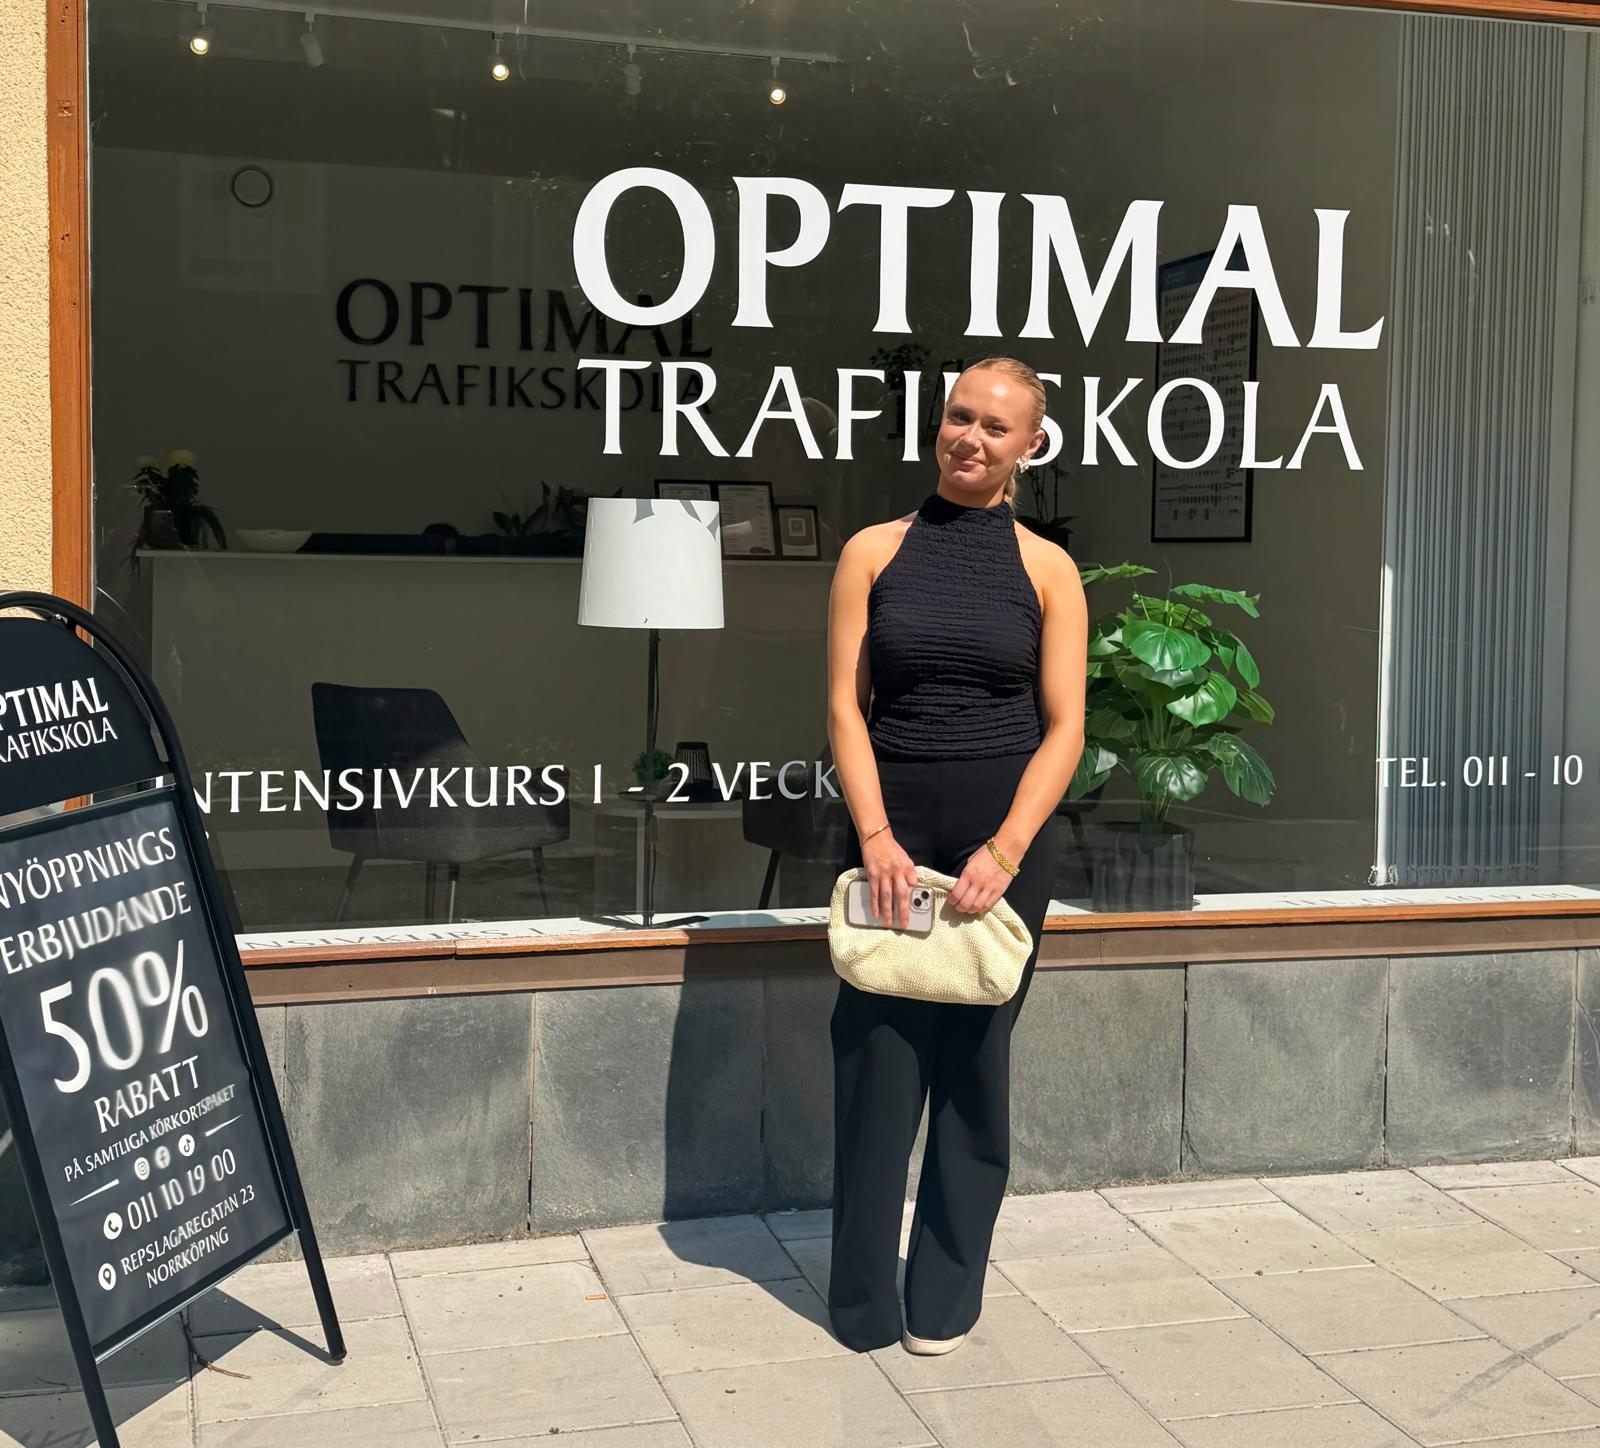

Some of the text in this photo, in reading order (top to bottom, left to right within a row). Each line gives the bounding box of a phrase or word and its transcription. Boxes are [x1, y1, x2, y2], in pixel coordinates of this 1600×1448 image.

[572, 166, 1385, 350] OPTIMAL
[335, 277, 713, 358] OPTIMAL
[577, 358, 1364, 471] TRAFISKOLA
[0, 717, 118, 763] AFIKSKOLA
[1375, 757, 1447, 788] TEL.
[1463, 755, 1509, 787] 011
[1552, 754, 1584, 786] 10
[156, 764, 567, 814] NTENSIVKURS
[665, 762, 690, 803] 2
[0, 881, 192, 974] ERBJUDANDE
[39, 939, 210, 1094] 50%
[64, 1083, 236, 1182] PÅ SAMTLIGA KÖRKORTSPAKET
[94, 1055, 199, 1134] RABATT
[120, 1184, 256, 1275] REPSLAGAREGATAN 23
[127, 1148, 236, 1231] 011 10 19 00
[146, 1226, 230, 1289] NORRKÖPING
